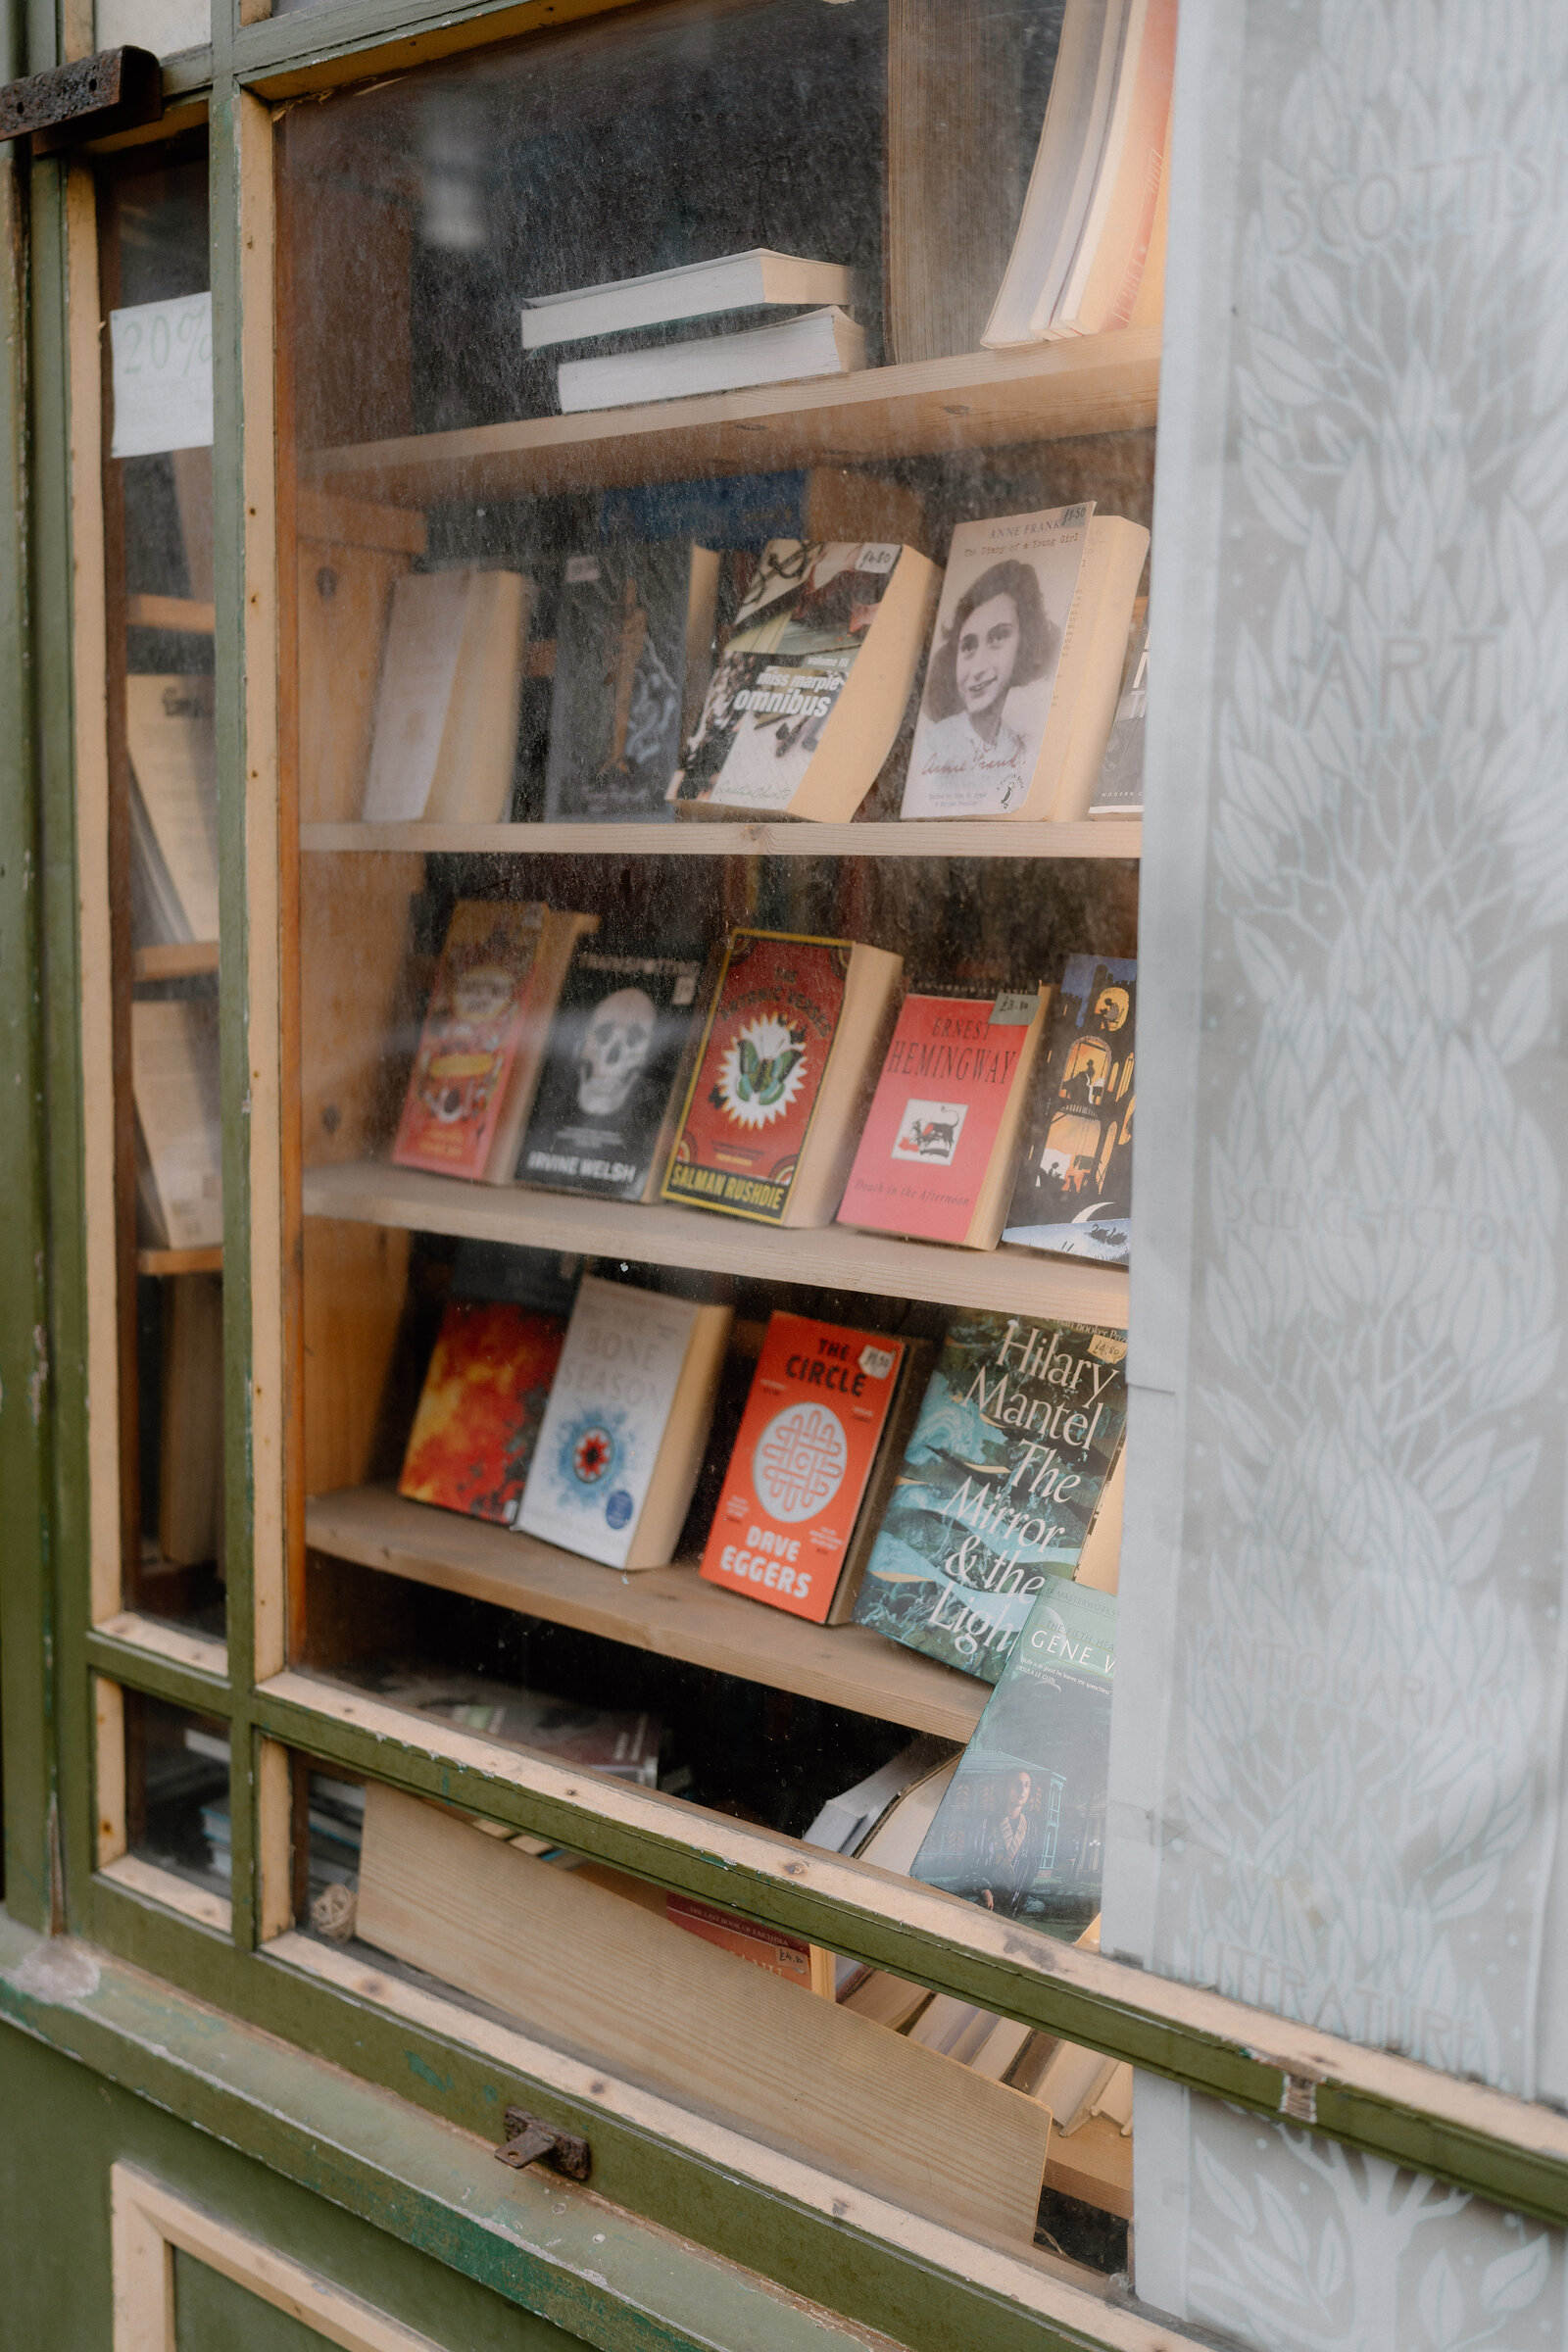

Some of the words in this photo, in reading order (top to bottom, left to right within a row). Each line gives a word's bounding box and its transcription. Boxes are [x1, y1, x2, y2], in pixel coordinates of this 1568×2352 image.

[123, 305, 213, 377] 20%
[989, 525, 1021, 540] ANNE
[1023, 519, 1060, 534] FRANK
[756, 670, 790, 688] miss
[791, 673, 840, 693] marple
[808, 656, 837, 667] volume
[1305, 631, 1498, 730] ART
[733, 689, 832, 717] omnibus
[787, 989, 832, 1039] VERSES
[932, 1016, 991, 1042] ERNEST
[887, 1040, 1018, 1085] HEMINGWAY
[527, 1151, 577, 1175] IRVINE
[578, 1155, 636, 1183] WELSH
[672, 1165, 724, 1197] SALMAN
[726, 1176, 785, 1210] RUSHDIE
[855, 1178, 884, 1194] Death
[886, 1184, 898, 1196] in
[900, 1185, 917, 1199] the
[920, 1189, 971, 1206] Afternoon
[581, 1328, 661, 1372] BONE
[817, 1337, 851, 1360] THE
[995, 1324, 1120, 1409] Hilary
[563, 1359, 661, 1411] SEASON
[785, 1352, 868, 1397] CIRCLE
[962, 1369, 1103, 1450] Mantel
[1009, 1438, 1082, 1504] The
[944, 1477, 1066, 1553] Mirror
[745, 1524, 802, 1562] DAVE
[719, 1544, 812, 1598] EGGERS
[945, 1535, 979, 1577] &
[984, 1548, 1047, 1604] the
[928, 1578, 1023, 1654] Ligh
[1046, 1587, 1056, 1595] SF
[1056, 1589, 1116, 1616] MASTERWORKS
[1030, 1629, 1095, 1666] GENE
[1047, 1620, 1064, 1634] THE
[1067, 1626, 1094, 1643] FIFTH
[1043, 1665, 1056, 1675] good
[1200, 1629, 1507, 1744] ANTIQUARIAN
[1186, 1933, 1482, 2069] LITERATURE
